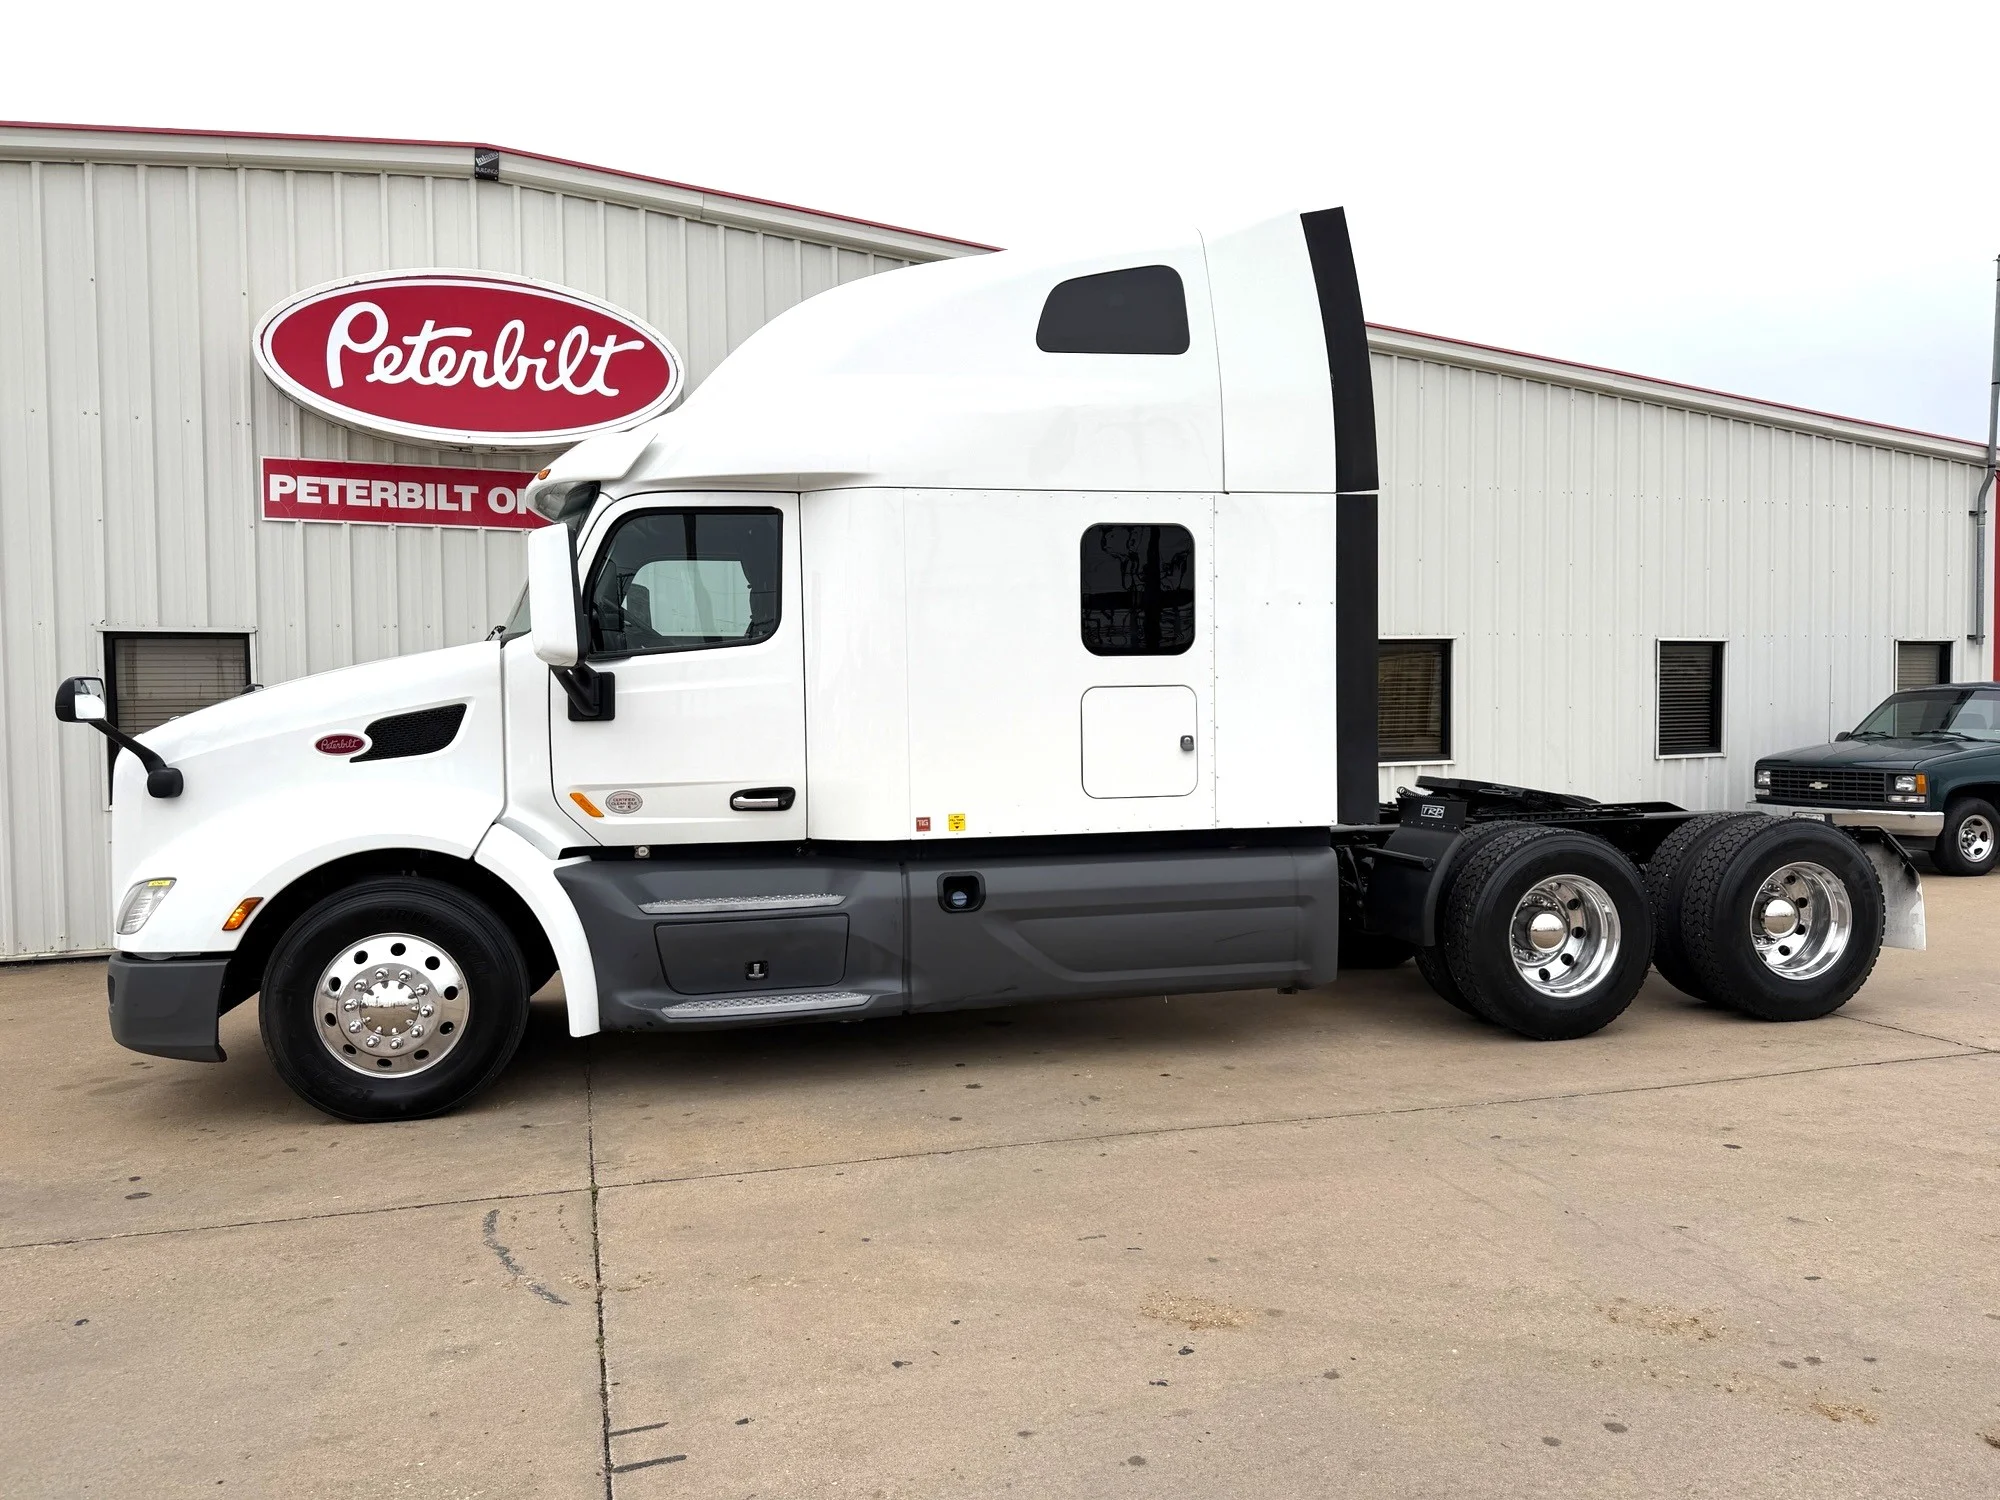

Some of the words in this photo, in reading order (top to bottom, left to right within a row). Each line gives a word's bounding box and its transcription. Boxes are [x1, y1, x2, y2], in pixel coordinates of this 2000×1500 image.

[326, 301, 645, 397] Peterbilt
[269, 474, 479, 512] PETERBILT
[321, 739, 359, 750] Peterbilt
[1422, 805, 1444, 816] TRP
